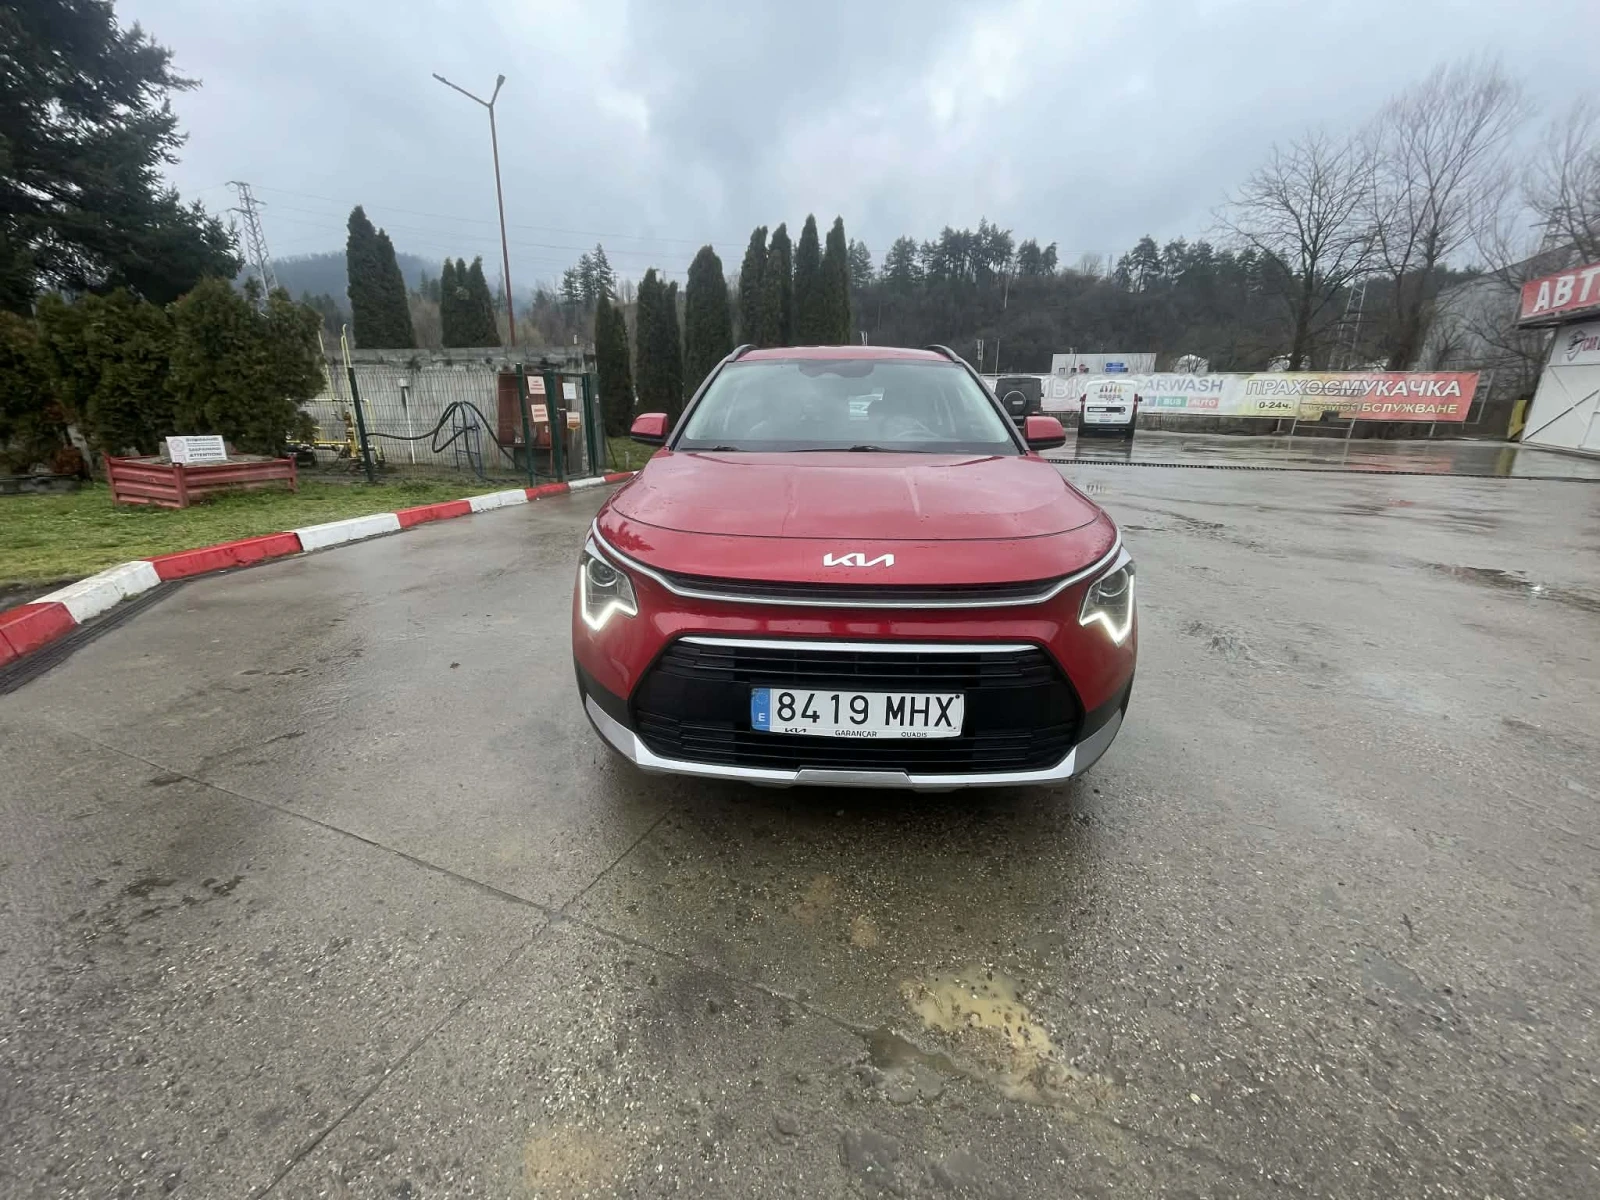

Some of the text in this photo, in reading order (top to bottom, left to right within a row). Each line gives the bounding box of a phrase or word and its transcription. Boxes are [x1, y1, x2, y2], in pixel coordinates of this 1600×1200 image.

[1533, 266, 1600, 313] АВТ
[1246, 380, 1462, 397] ПРАХОСМУКАЧКА
[1188, 398, 1217, 407] AUTO
[823, 552, 895, 568] KIA
[757, 691, 955, 728] E 8419 MHX
[834, 729, 878, 738] GARANCAR
